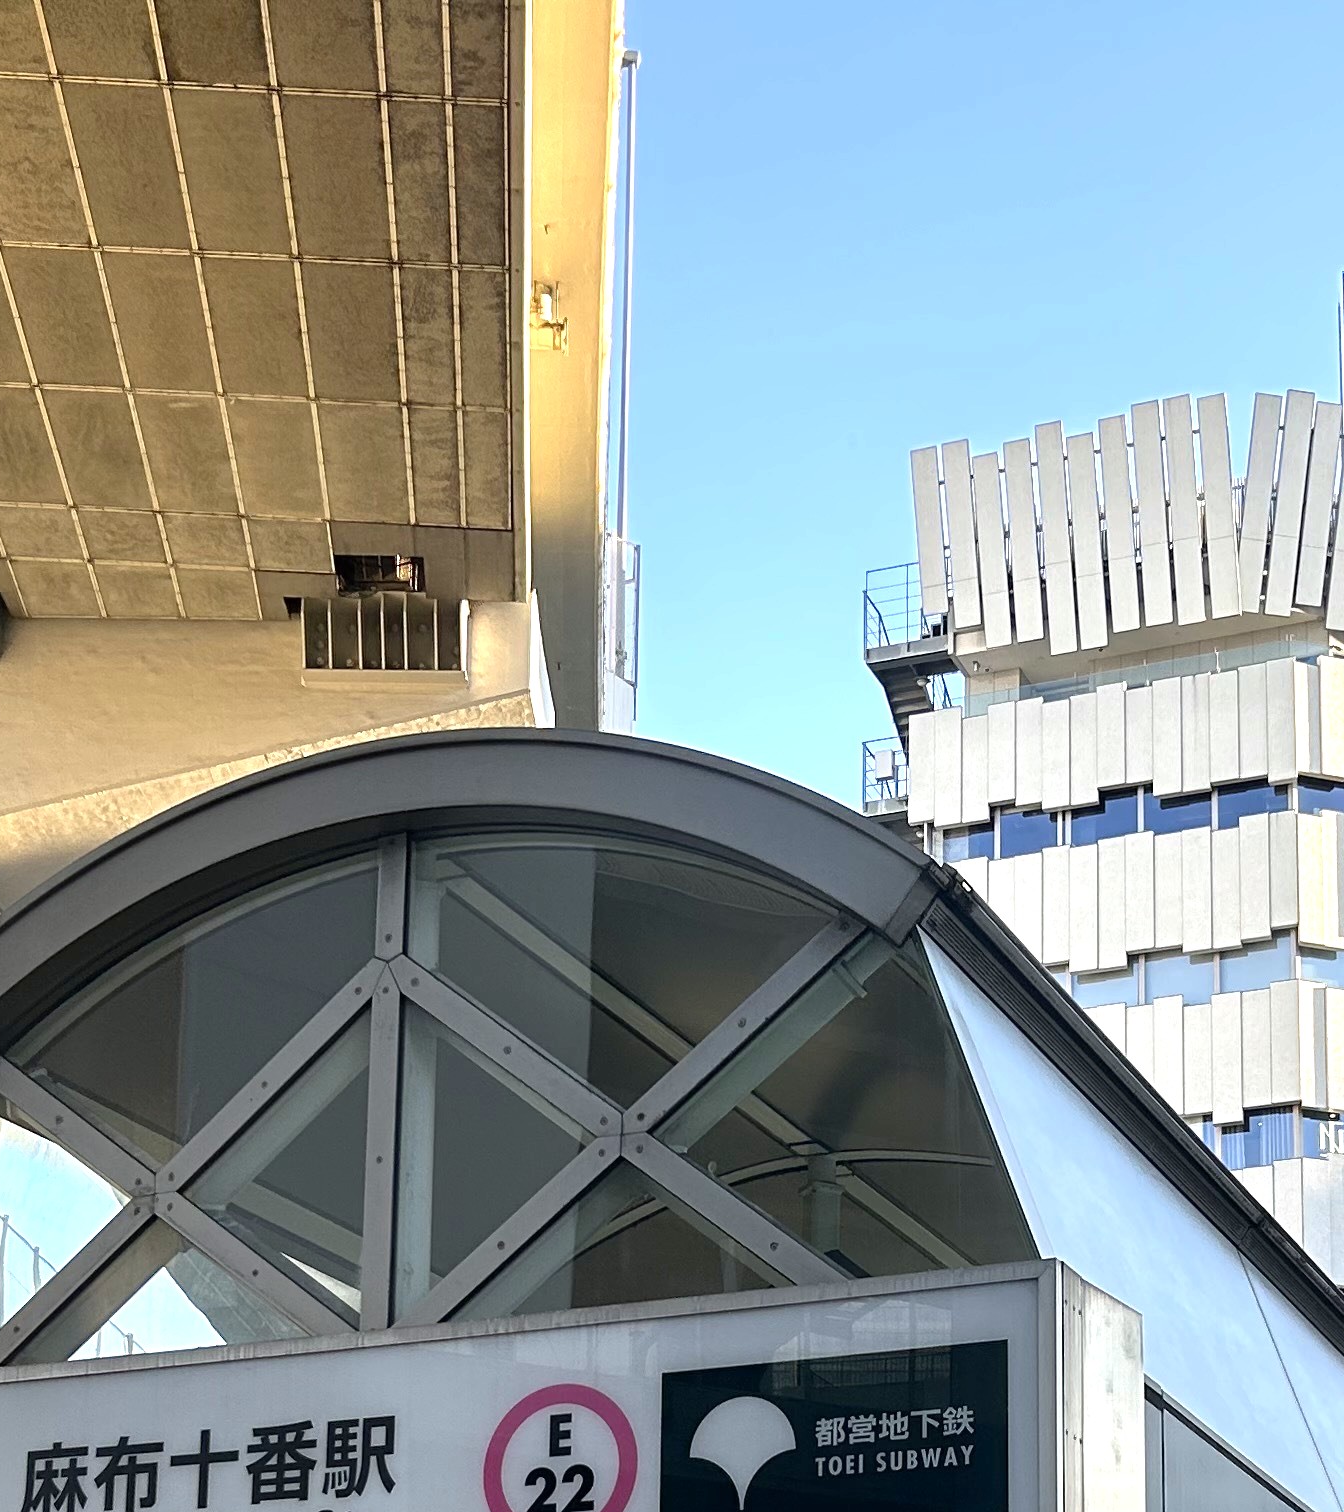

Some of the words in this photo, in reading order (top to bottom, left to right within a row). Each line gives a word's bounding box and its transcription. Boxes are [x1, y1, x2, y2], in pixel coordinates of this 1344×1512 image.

[549, 1413, 572, 1457] E
[815, 1405, 975, 1447] 都営地下鉄
[815, 1453, 864, 1477] TOEI
[876, 1444, 974, 1473] SUBWAY
